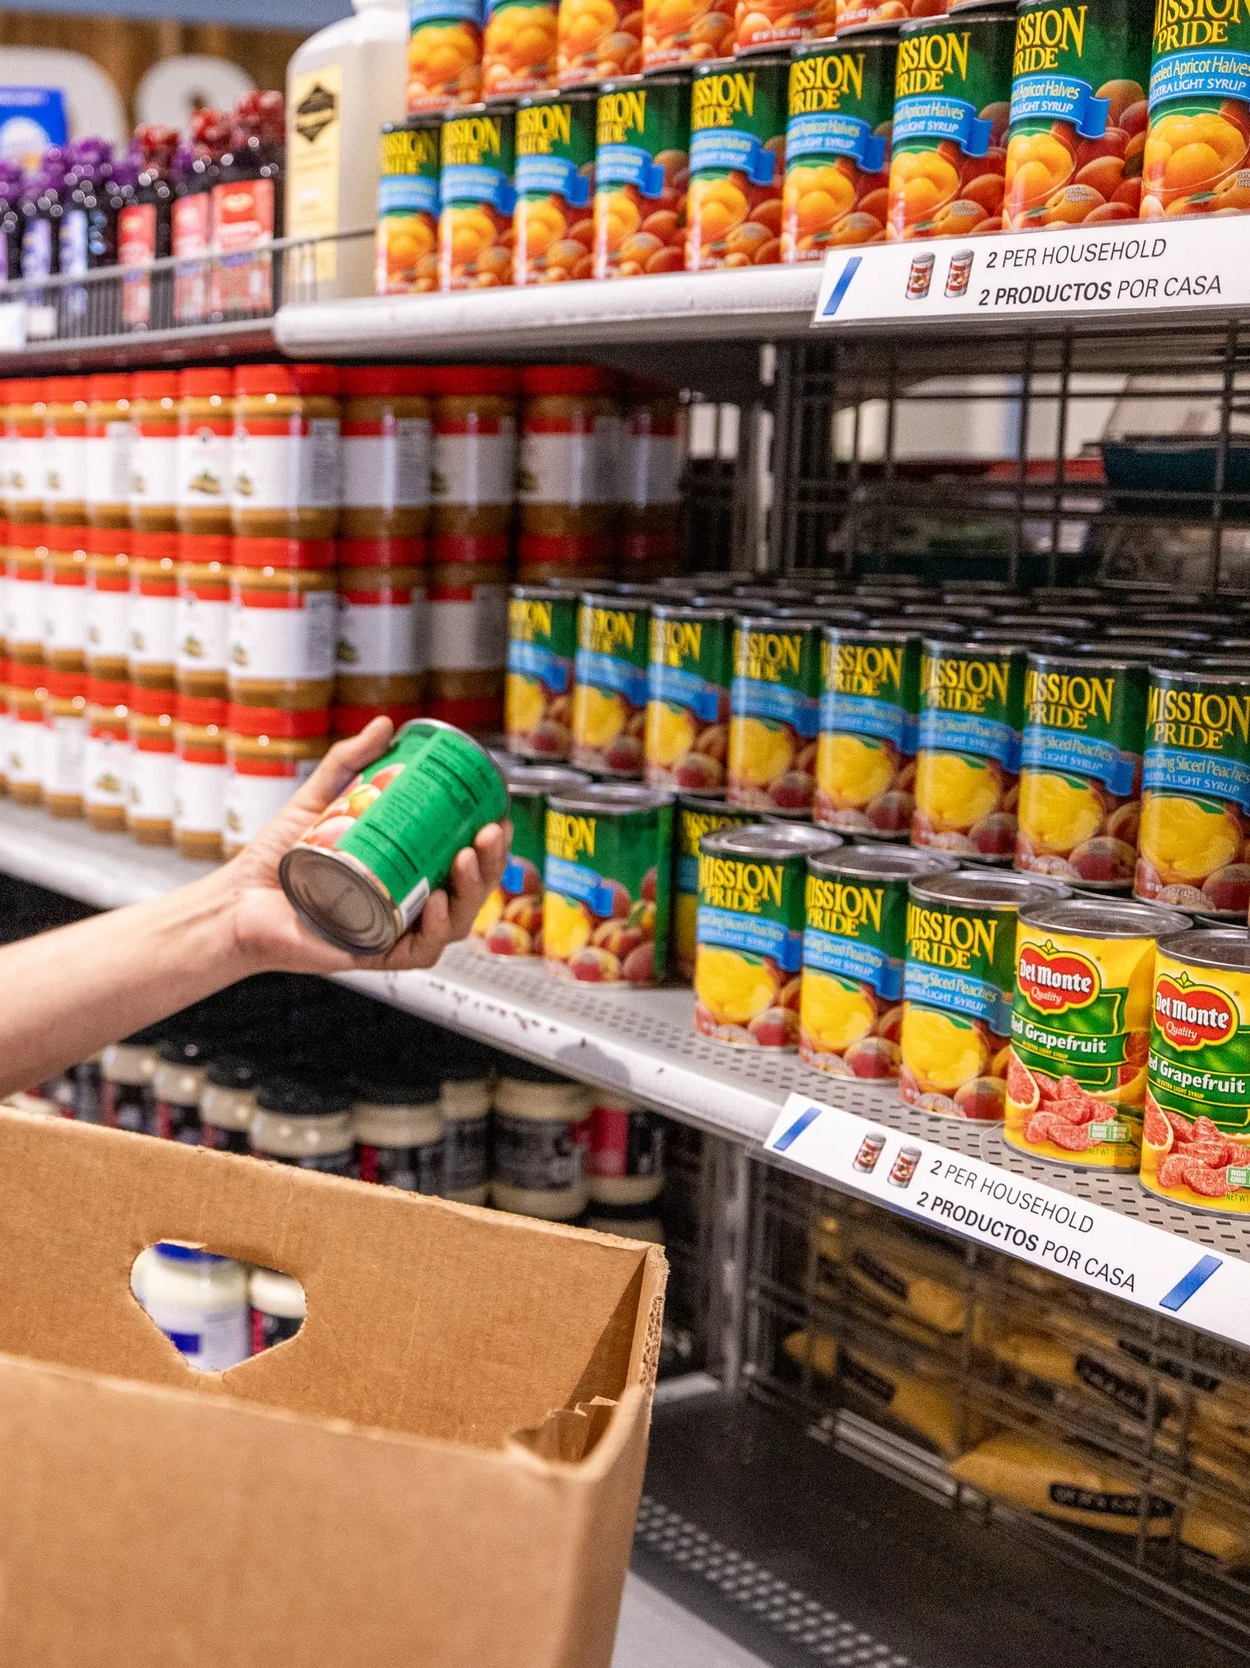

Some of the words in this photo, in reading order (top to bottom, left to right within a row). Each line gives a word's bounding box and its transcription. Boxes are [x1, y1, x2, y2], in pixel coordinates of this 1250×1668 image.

[1157, 20, 1229, 54] PRIDE
[1173, 58, 1211, 81] Apricot
[1045, 80, 1081, 100] Halves
[1173, 78, 1205, 92] LIGHT
[1207, 77, 1247, 92] SYRUP
[1041, 100, 1074, 113] SYRUP
[986, 252, 998, 269] 2
[1002, 248, 1036, 268] PER
[1041, 238, 1167, 266] HOUSEHOLD
[978, 288, 990, 306] 2
[994, 281, 1113, 306] PRODUCTOS
[1117, 278, 1159, 300] POR
[1164, 274, 1222, 297] CASA
[1029, 703, 1088, 730] PRIDE
[1147, 685, 1250, 745] MISSION
[1154, 722, 1224, 750] PRIDE
[1172, 773, 1200, 787] LIGHT
[1204, 779, 1240, 794] SYRUP
[1176, 755, 1206, 774] Sliced
[1207, 760, 1250, 785] Peaches
[703, 886, 762, 913] PRIDE
[807, 905, 860, 937] PRIDE
[911, 938, 972, 970] PRIDE
[1019, 958, 1035, 982] Del
[1036, 970, 1092, 994] Monte
[955, 978, 997, 1003] Peaches
[1030, 986, 1063, 1005] Quality
[1155, 991, 1170, 1016] Del
[1172, 999, 1229, 1030] Monte
[1025, 1023, 1107, 1054] Grapefruit
[1166, 1021, 1197, 1041] Quality
[1160, 1060, 1246, 1094] Grapefruit
[1173, 1083, 1187, 1095] LIGHT
[1187, 1088, 1205, 1100] SYRUP
[1230, 1168, 1247, 1177] NON
[1230, 1176, 1247, 1184] GMO
[930, 1159, 943, 1176] 2
[944, 1165, 977, 1190] PER
[980, 1177, 1095, 1234] HOUSEHOLD
[1225, 1193, 1238, 1201] NET
[916, 1191, 929, 1207] 2
[931, 1196, 1039, 1252] PRODUCTOS
[1041, 1240, 1080, 1270] POR
[1084, 1257, 1136, 1293] CASA
